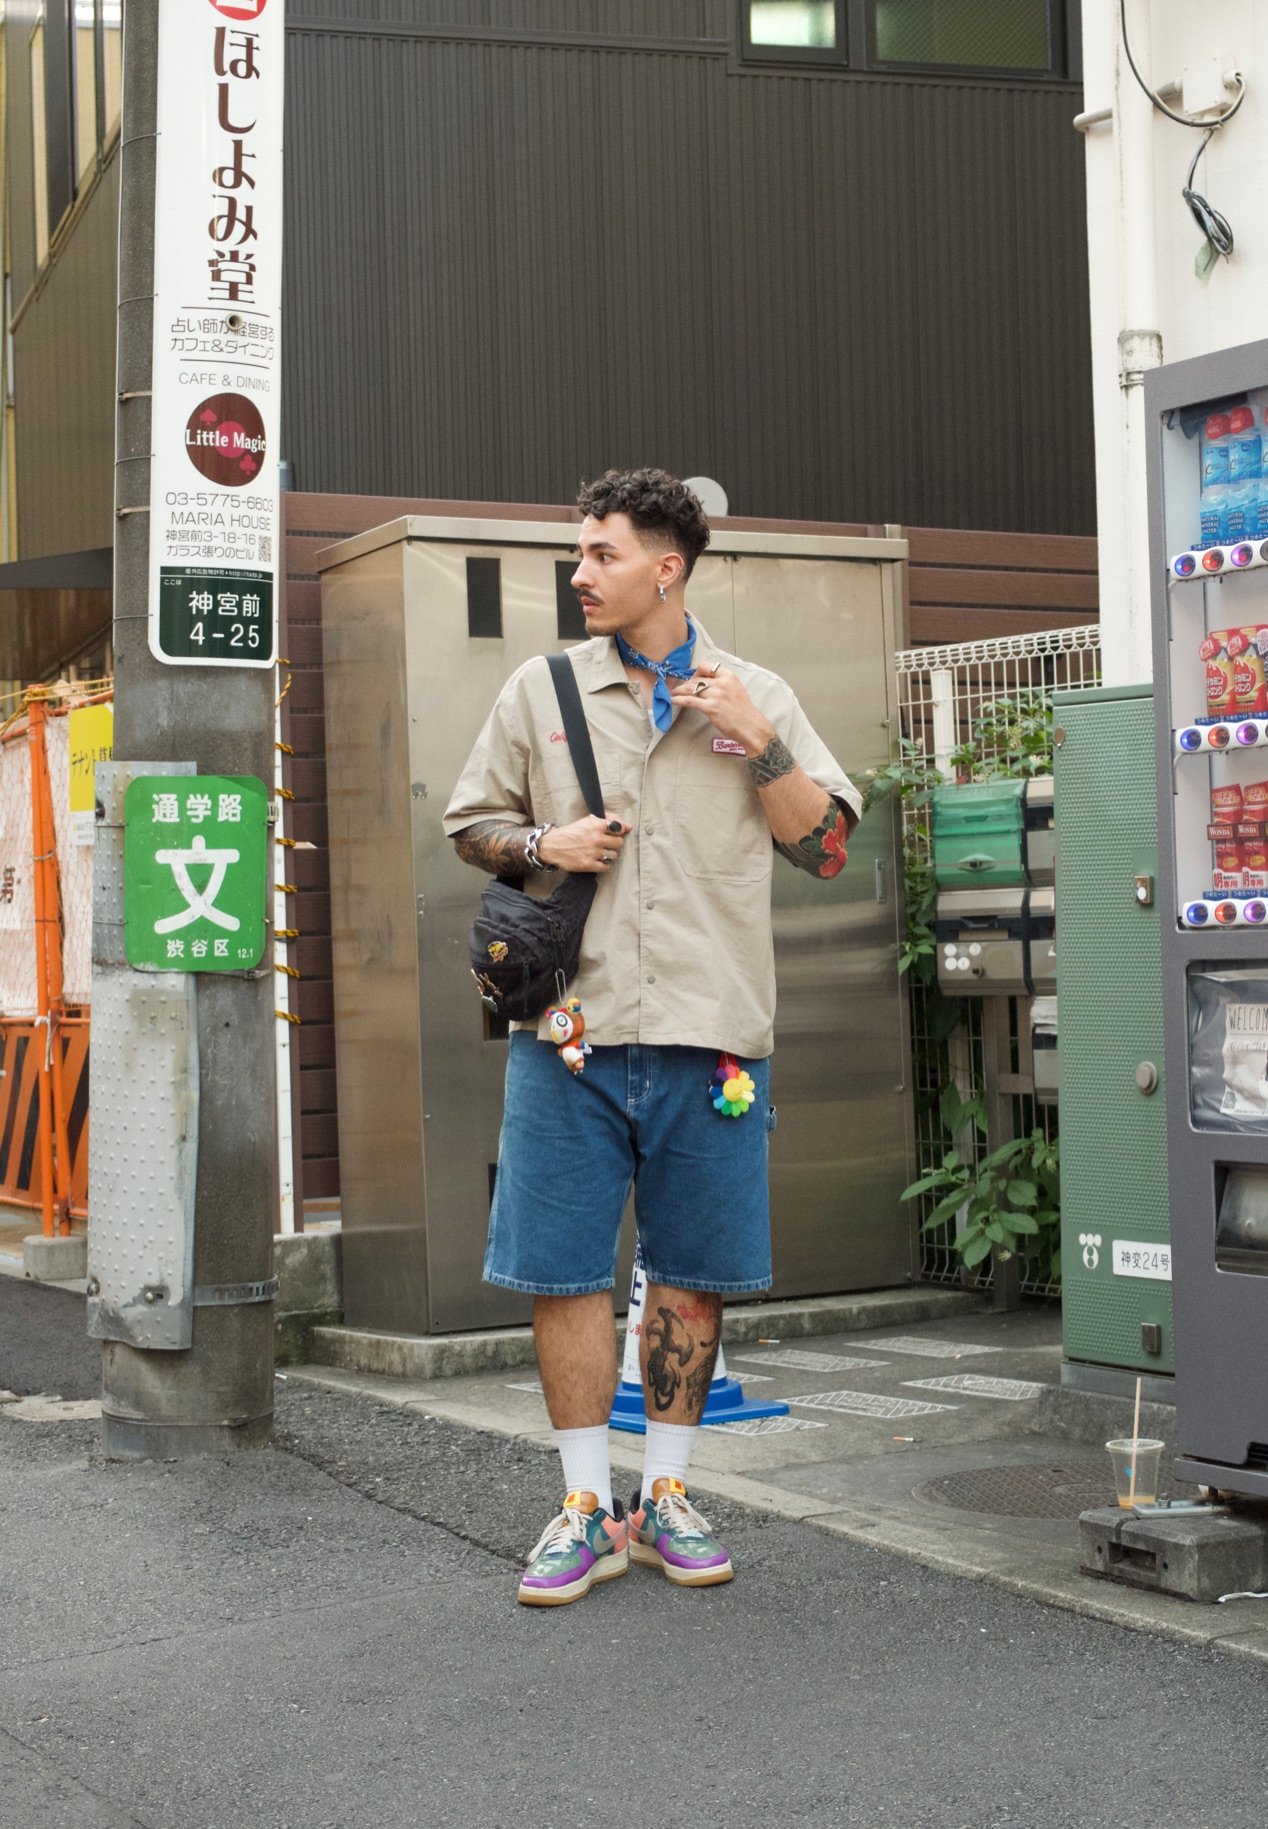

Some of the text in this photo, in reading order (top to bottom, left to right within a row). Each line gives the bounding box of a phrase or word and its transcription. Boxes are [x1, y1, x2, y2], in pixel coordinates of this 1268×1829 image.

[208, 26, 260, 304] ほしよみ堂
[179, 372, 271, 393] CAFE & DINING
[186, 427, 267, 453] Little Magic
[165, 491, 274, 513] 03-5775-6603
[171, 511, 271, 532] MARIA HOUSE
[165, 529, 257, 546] 神宮前3-18-16
[167, 545, 255, 560] ガラス張りのビル
[188, 590, 261, 617] 神宮前
[189, 622, 260, 648] 4-25
[152, 793, 242, 823] 通学路
[1208, 826, 1231, 837] WONDA
[1238, 824, 1257, 834] WONDA
[166, 939, 230, 958] 渋谷区
[237, 947, 254, 959] 12.1
